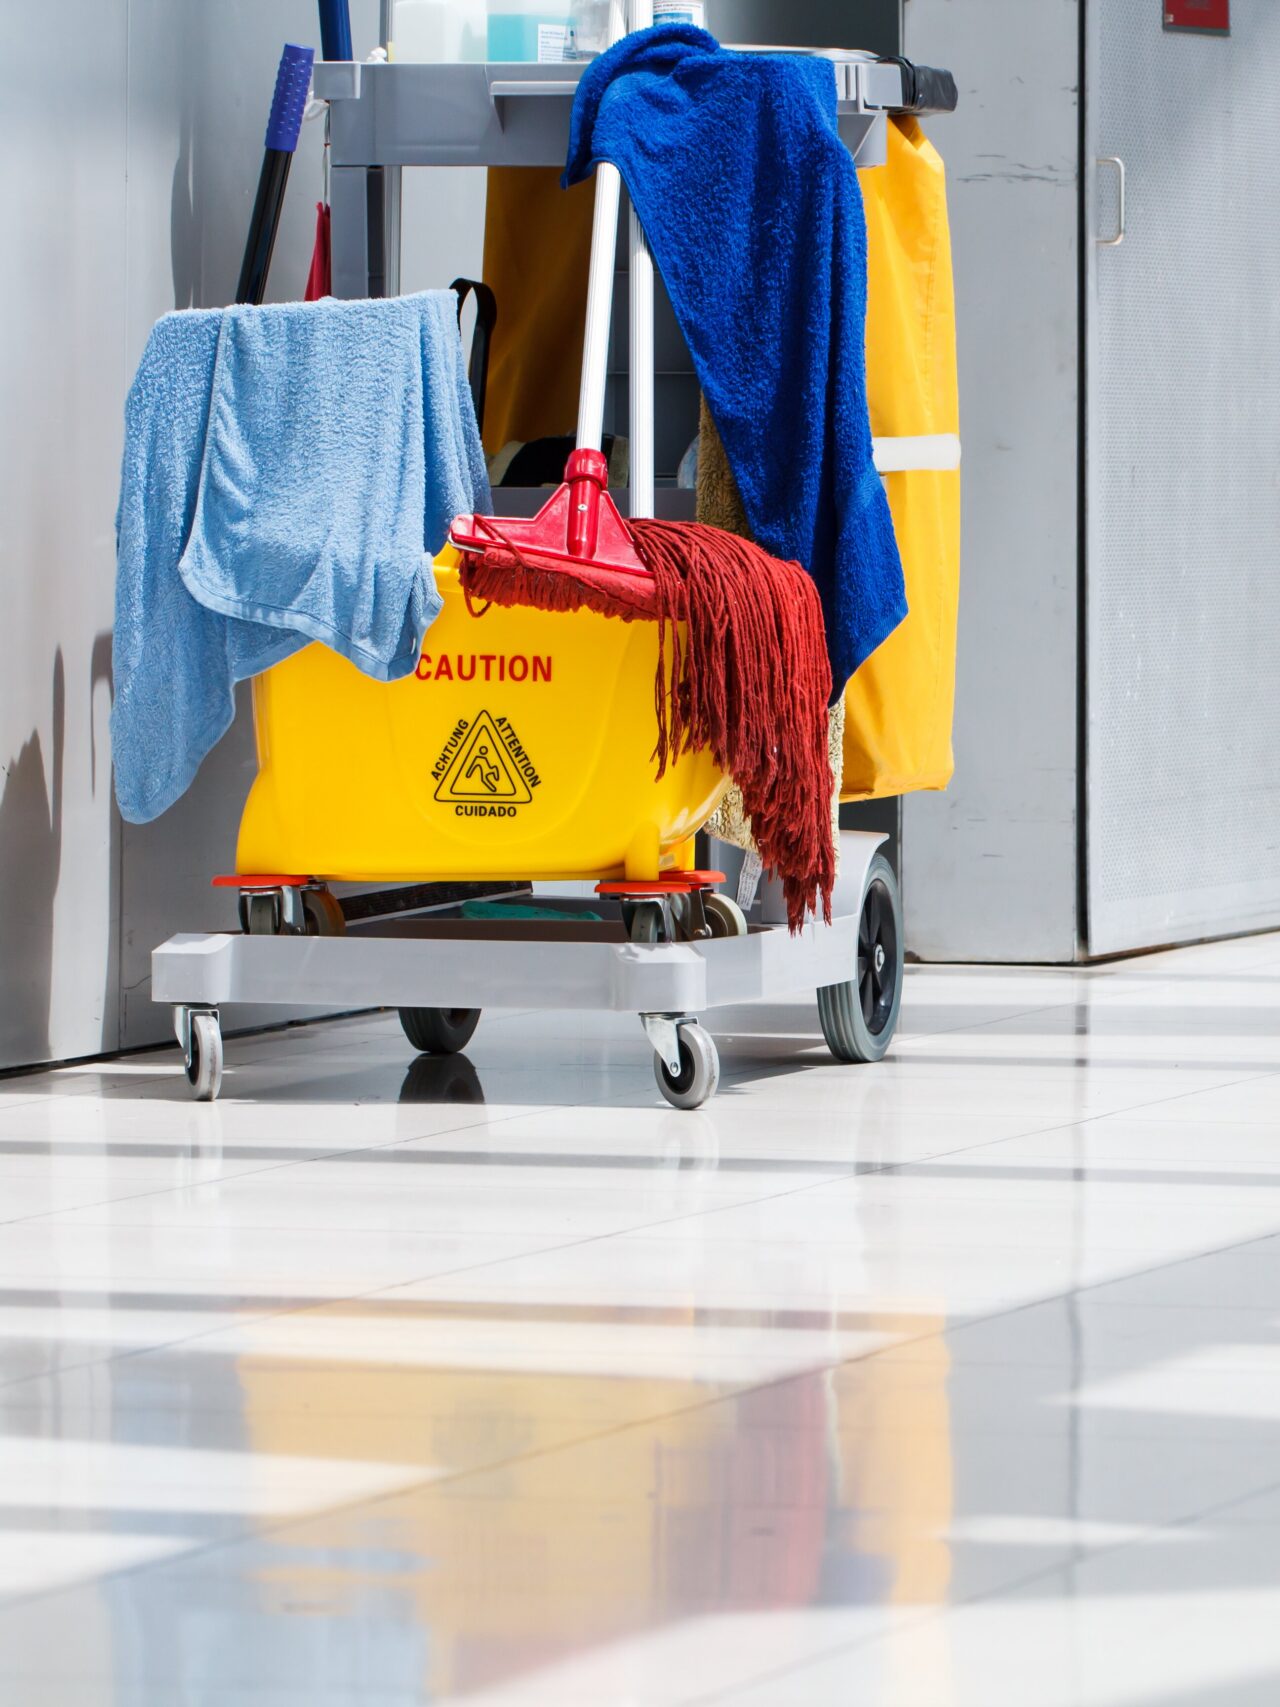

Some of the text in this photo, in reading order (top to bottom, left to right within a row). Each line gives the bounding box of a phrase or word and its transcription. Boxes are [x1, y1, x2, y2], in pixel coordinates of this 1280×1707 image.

[415, 654, 552, 682] CAUTION
[431, 719, 469, 781] ACHTUNG
[495, 717, 542, 788] ATTENTION
[455, 805, 517, 817] CUIDADO
